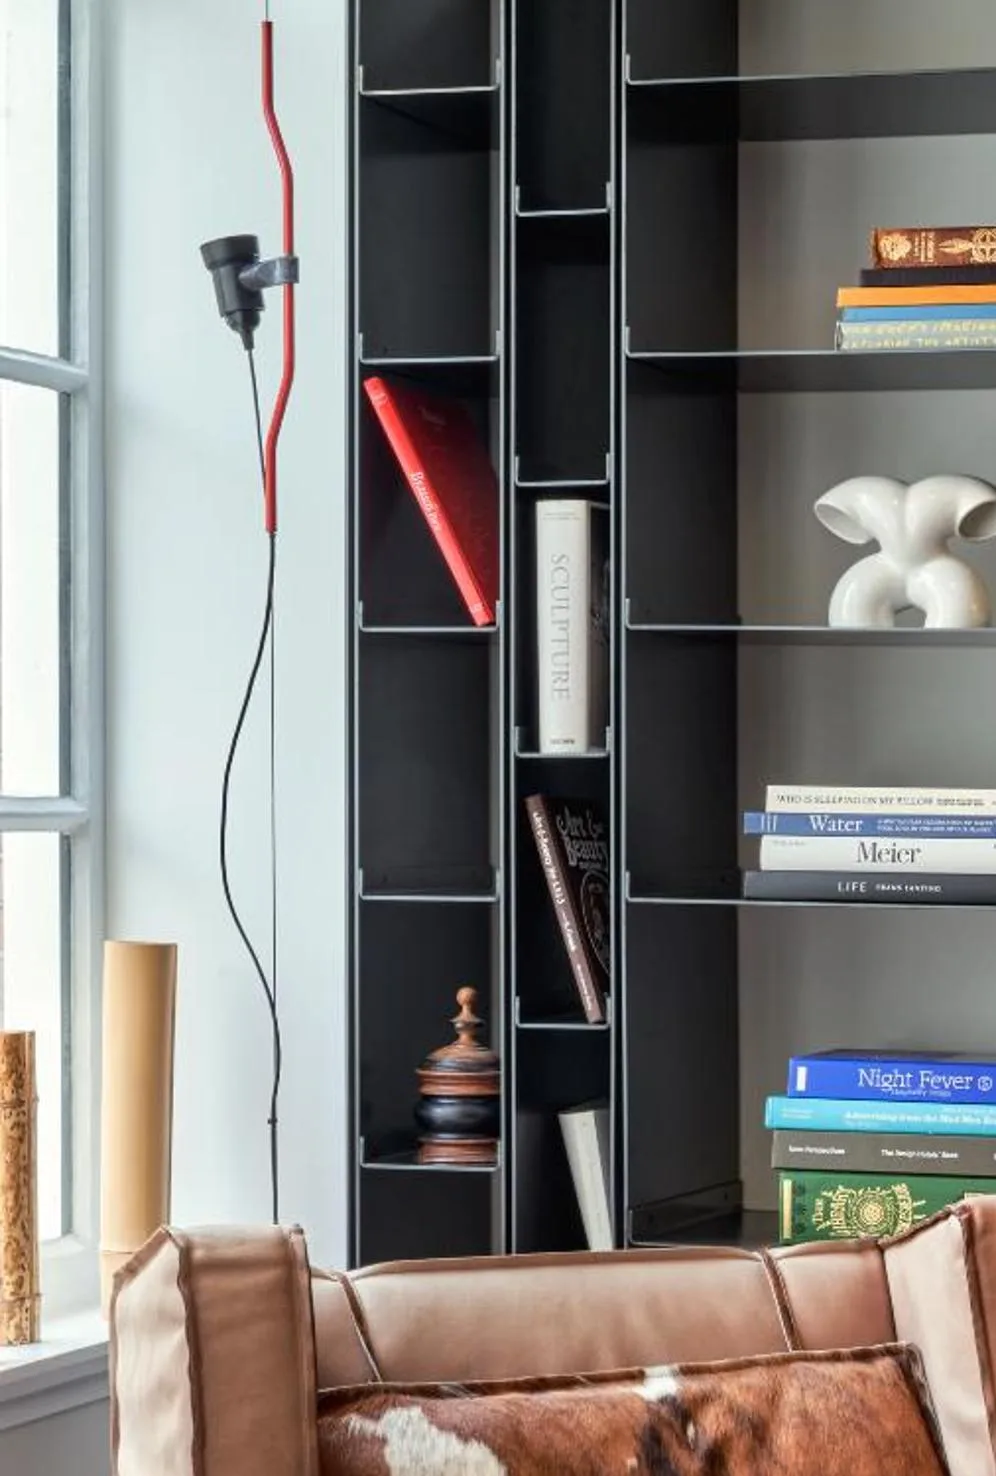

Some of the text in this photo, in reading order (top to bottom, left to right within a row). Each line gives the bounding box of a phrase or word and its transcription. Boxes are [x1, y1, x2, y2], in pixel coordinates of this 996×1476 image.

[549, 553, 572, 701] SCULPTURE
[813, 796, 862, 806] SLEEPING
[809, 815, 864, 832] Water
[856, 841, 922, 864] Meier
[837, 881, 868, 893] LIFE
[857, 1067, 973, 1092] Night Fever
